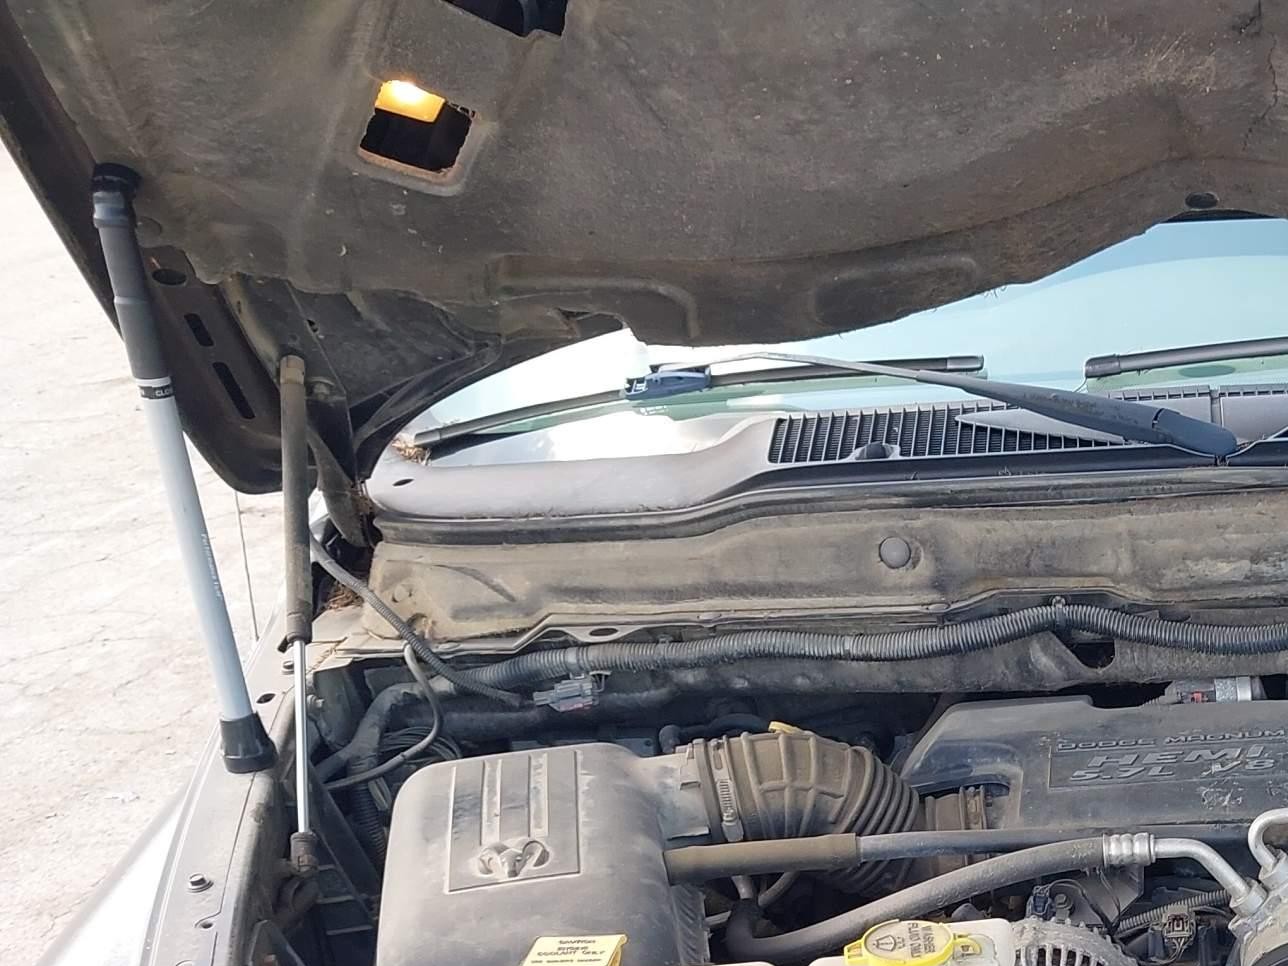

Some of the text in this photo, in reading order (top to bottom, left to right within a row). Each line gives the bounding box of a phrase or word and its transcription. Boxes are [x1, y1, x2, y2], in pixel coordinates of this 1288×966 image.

[1164, 728, 1286, 745] MAGNUM
[1086, 743, 1268, 768] HEMI
[1070, 757, 1275, 781] 5.7L V8
